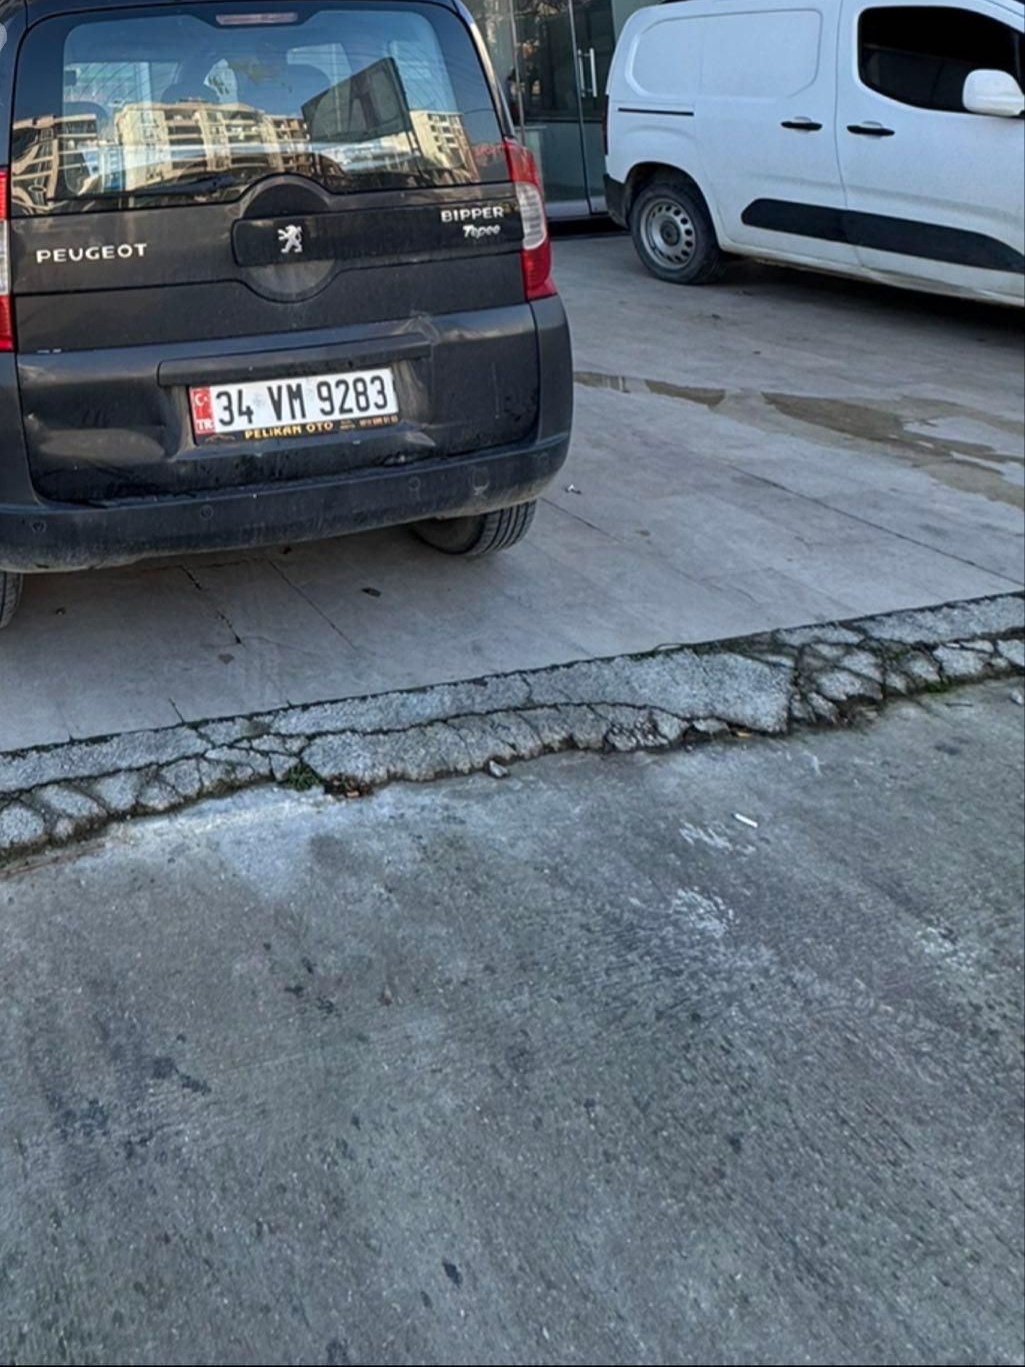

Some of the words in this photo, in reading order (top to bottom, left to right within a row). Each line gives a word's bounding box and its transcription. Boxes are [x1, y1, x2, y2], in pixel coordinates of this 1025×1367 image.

[440, 205, 504, 223] BIPPER
[462, 223, 501, 239] Tepee
[36, 243, 147, 263] PEUGEOT
[215, 389, 254, 427] 34
[267, 382, 306, 421] VM
[317, 375, 388, 416] 9283
[306, 421, 334, 433] OTO
